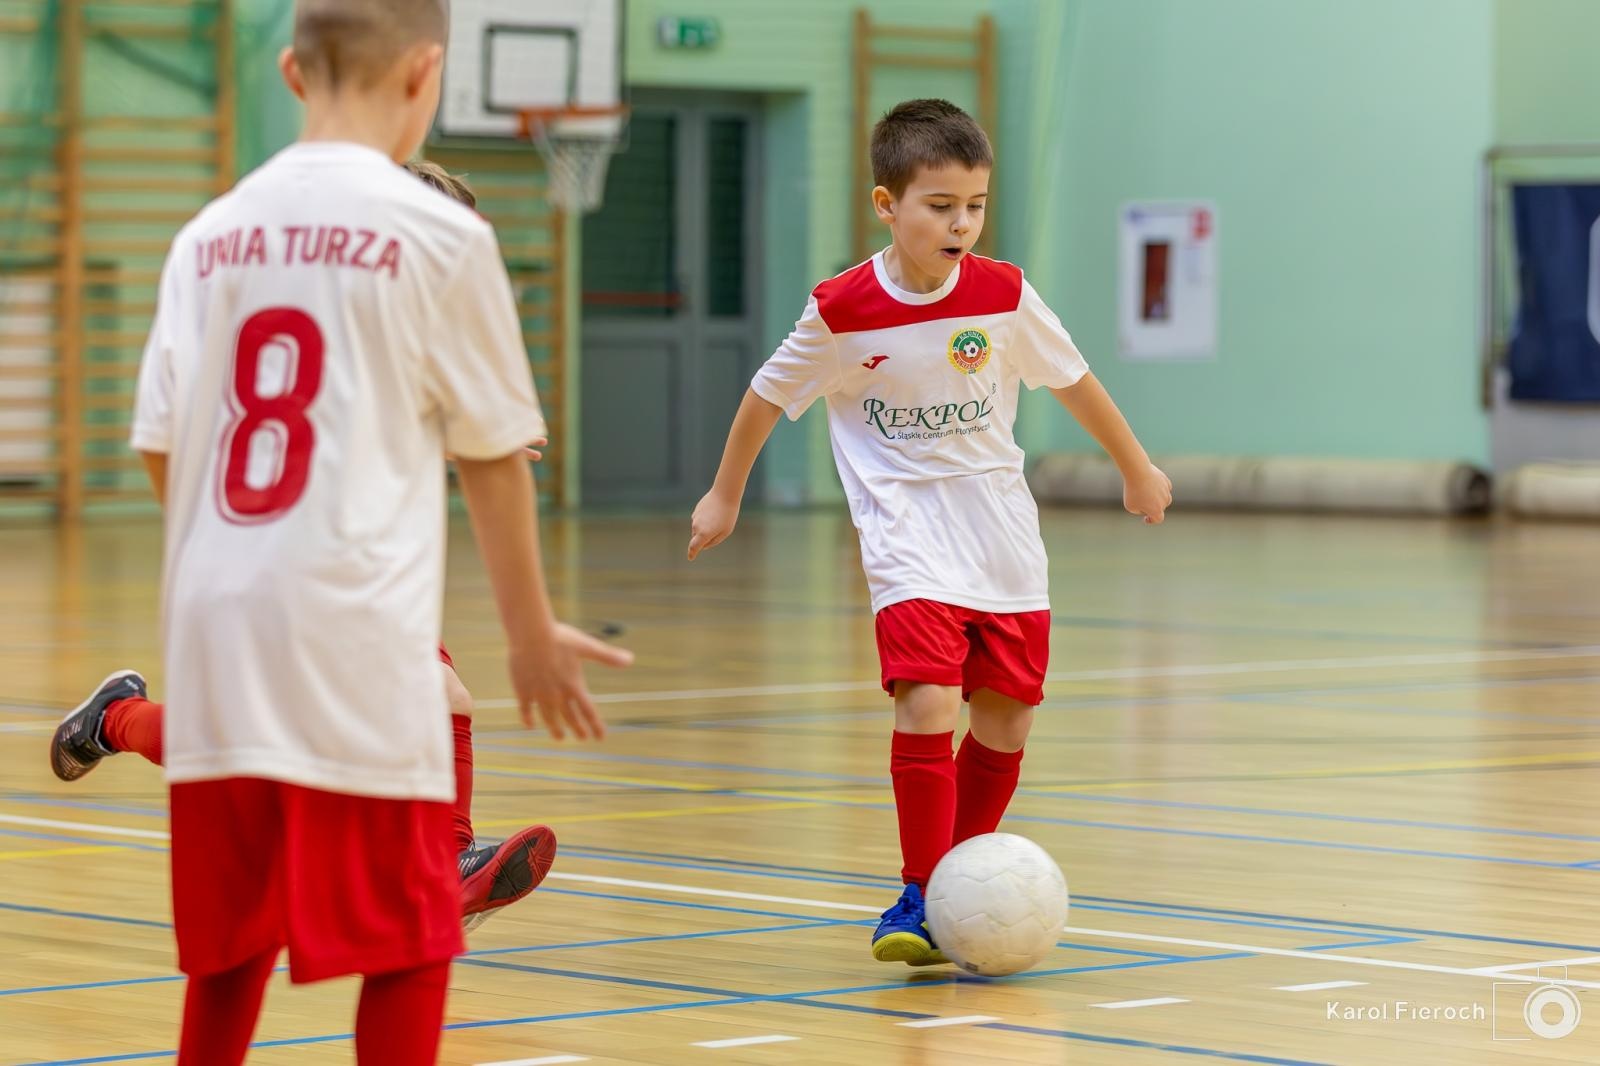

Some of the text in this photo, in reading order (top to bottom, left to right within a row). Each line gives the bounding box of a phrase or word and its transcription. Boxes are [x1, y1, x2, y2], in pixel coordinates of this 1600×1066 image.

[281, 226, 402, 280] TURZA
[213, 305, 325, 526] 8
[863, 396, 994, 440] REKPOL
[897, 430, 921, 440] Śląskie
[923, 429, 954, 440] Centrum
